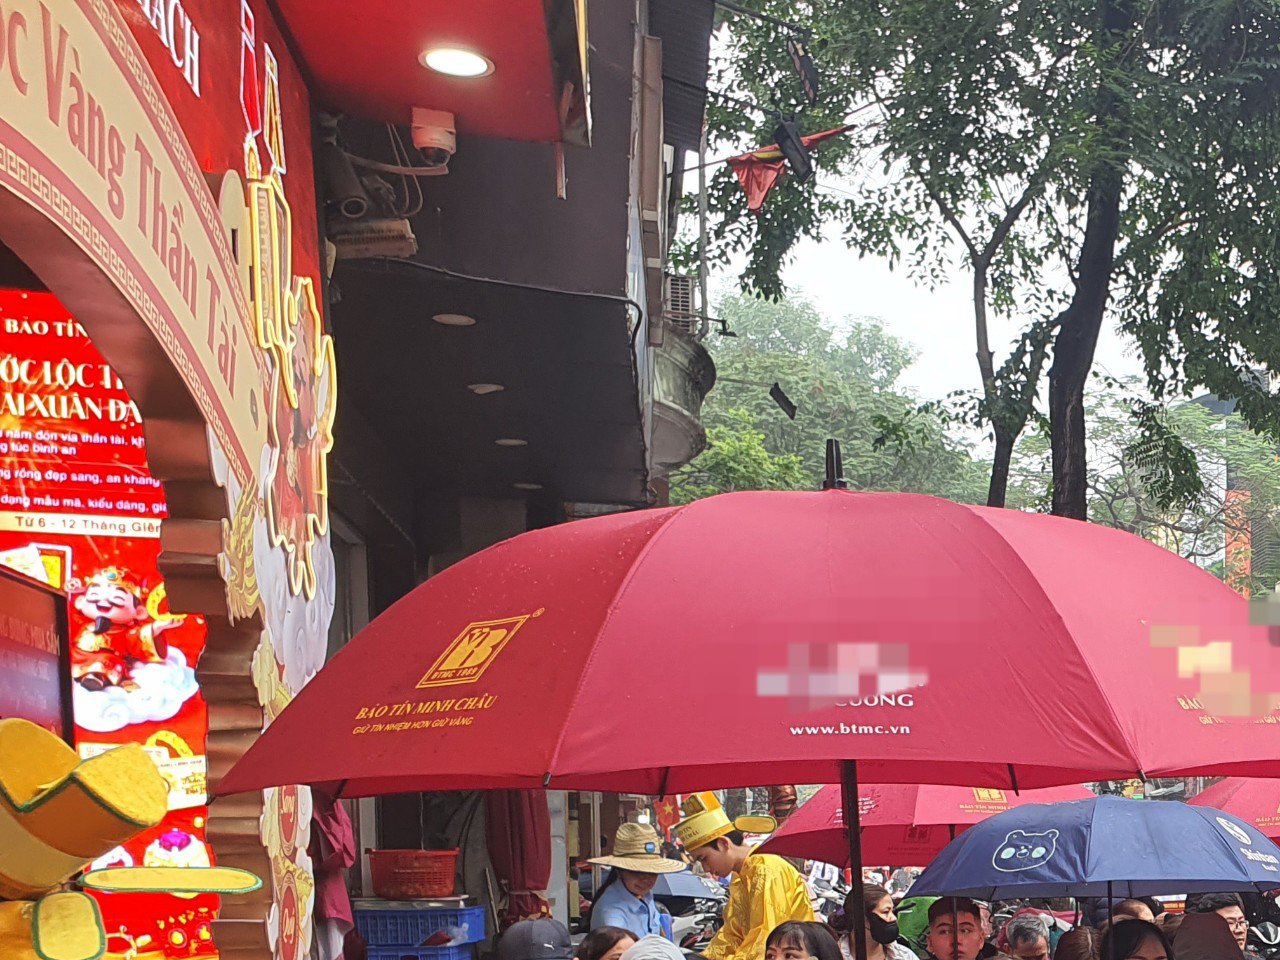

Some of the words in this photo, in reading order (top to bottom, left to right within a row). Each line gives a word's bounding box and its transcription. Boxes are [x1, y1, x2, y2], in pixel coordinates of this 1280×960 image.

[41, 0, 126, 220] Vàng
[134, 134, 199, 319] Thần
[206, 265, 238, 400] Tài
[5, 316, 48, 335] BẢO
[106, 474, 121, 483] an
[38, 517, 46, 527] 6
[62, 519, 76, 529] 12
[355, 703, 388, 720] BẢO
[388, 700, 415, 716] TÍN
[412, 700, 455, 715] MINH
[454, 692, 498, 711] CHÂU
[789, 722, 911, 735] www.btmc.vn
